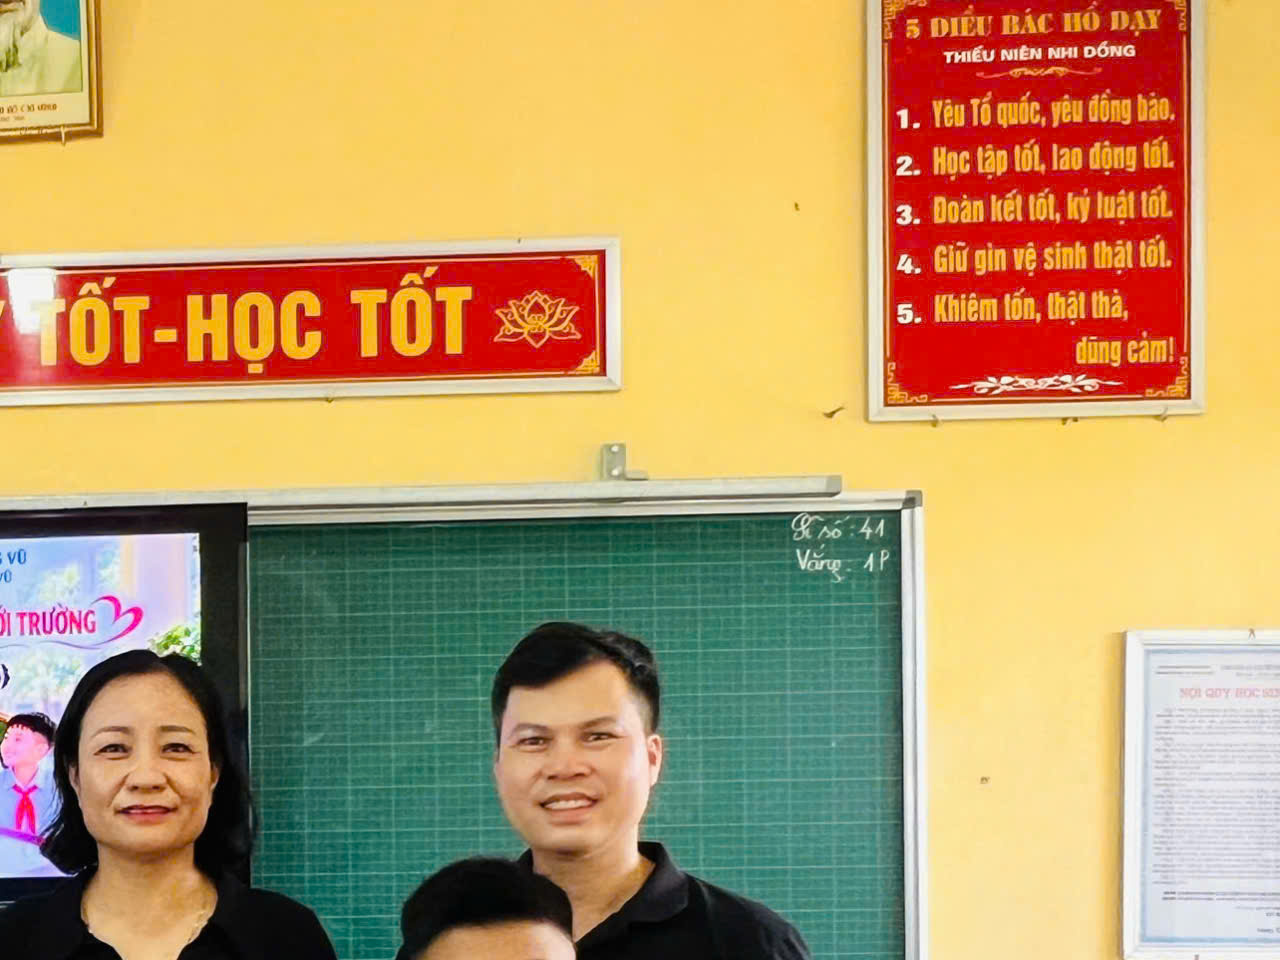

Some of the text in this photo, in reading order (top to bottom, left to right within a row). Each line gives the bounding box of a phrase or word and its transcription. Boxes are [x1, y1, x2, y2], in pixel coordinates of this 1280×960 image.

[905, 18, 920, 39] 5
[1002, 8, 1054, 35] BÁC
[1111, 9, 1162, 37] DẠY
[944, 45, 995, 64] THIẾU
[1001, 45, 1042, 62] NIÊN
[1048, 47, 1078, 60] NHI
[896, 109, 921, 129] 1.
[932, 97, 965, 128] Yêu
[996, 91, 1047, 129] quốc,
[1051, 95, 1083, 129] yêu
[1088, 89, 1131, 126] đồng
[896, 136, 1175, 181] 2. Học tập tốt, lao động tốt.
[896, 205, 921, 225] 3.
[933, 195, 985, 224] Đoàn
[990, 188, 1023, 223] kết
[1028, 186, 1061, 224] tốt,
[1097, 188, 1135, 225] luật
[1141, 184, 1174, 218] tốt.
[896, 255, 921, 274] 4.
[934, 242, 969, 273] Giữ
[1013, 242, 1037, 277] vệ
[1043, 241, 1087, 271] sinh
[1094, 239, 1133, 274] thật
[1139, 234, 1173, 268] tốt.
[350, 265, 473, 358] TỐT
[896, 304, 922, 324] 5.
[934, 291, 998, 323] Khiêm
[1048, 291, 1086, 326] thật
[1075, 331, 1175, 367] dũng cảm!
[858, 515, 885, 540] 41
[7, 548, 28, 565] VŨ
[16, 602, 96, 636] TRƯỜNG
